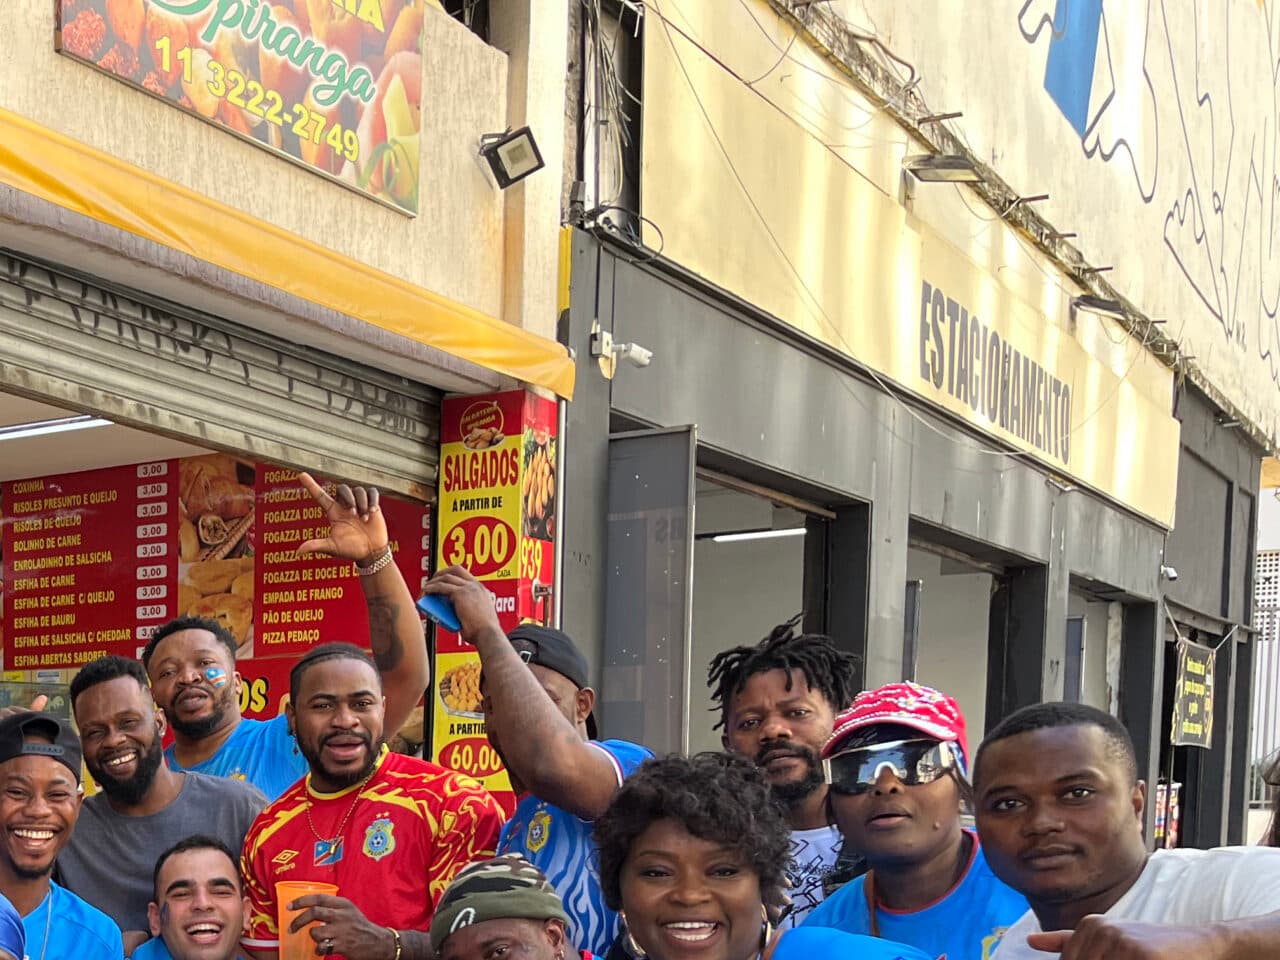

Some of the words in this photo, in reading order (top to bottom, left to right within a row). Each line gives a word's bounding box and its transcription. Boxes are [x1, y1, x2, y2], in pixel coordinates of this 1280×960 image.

[156, 36, 192, 83] 11
[206, 59, 360, 161] 3222-2749
[920, 279, 1070, 465] ESTACIONAMENTO
[142, 465, 162, 476] 3,00
[443, 447, 519, 493] SALGADOS
[13, 479, 44, 494] COXINHA
[142, 485, 162, 496] 3,00
[13, 500, 43, 514] RISOLES
[44, 494, 82, 509] PRESUNTO
[90, 490, 118, 504] QUEIJO
[264, 488, 300, 503] FOGAZZA
[459, 497, 490, 511] PARTIR
[491, 496, 503, 509] DE
[142, 505, 162, 516] 3,00
[264, 509, 300, 523] FOGAZZA
[303, 507, 322, 520] DOIS
[13, 518, 43, 533] RISOLES
[44, 517, 54, 529] DE
[55, 515, 82, 528] QUEIJO
[142, 526, 162, 537] 3,00
[13, 538, 45, 553] BOLINHO
[46, 536, 56, 548] DE
[58, 534, 82, 547] CARNE
[264, 529, 300, 544] FOGAZZA
[303, 528, 313, 539] DE
[142, 545, 162, 556] 3,00
[449, 522, 509, 573] 3,00
[14, 555, 63, 571] ENROLADINHO
[65, 554, 75, 566] DE
[76, 550, 112, 565] SALSICHA
[263, 550, 300, 564] FOGAZZA
[521, 536, 542, 580] 939
[142, 567, 162, 578] 3,00
[263, 570, 300, 584] FOGAZZA
[302, 569, 313, 581] DE
[315, 567, 337, 580] DOCE
[340, 566, 350, 577] DE
[496, 569, 511, 578] CADA
[14, 578, 38, 591] ESFIHA
[40, 577, 50, 588] DE
[51, 574, 75, 587] CARNE
[142, 586, 162, 597] 3,00
[263, 590, 294, 604] EMPADA
[297, 589, 307, 601] DE
[309, 586, 343, 600] FRANGO
[14, 597, 38, 610] ESFIHA
[40, 596, 50, 607] DE
[51, 594, 75, 606] CARNE
[87, 590, 115, 603] QUEIJO
[142, 606, 162, 616] 3,00
[263, 610, 279, 624] PÃO
[281, 610, 291, 622] DE
[293, 608, 324, 621] QUEIJO
[14, 617, 38, 629] ESFIHA
[40, 615, 50, 627] DE
[51, 613, 76, 626] BAURU
[14, 636, 39, 648] ESFIHA
[40, 635, 50, 647] DE
[51, 632, 87, 646] SALSICHA
[96, 628, 131, 642] CHEDDAR
[263, 631, 285, 644] PIZZA
[288, 629, 320, 644] PEDAÇO
[14, 655, 39, 667] ESFIHA
[40, 652, 73, 665] ABERTAS
[449, 723, 455, 735] A
[451, 744, 501, 775] 60,00
